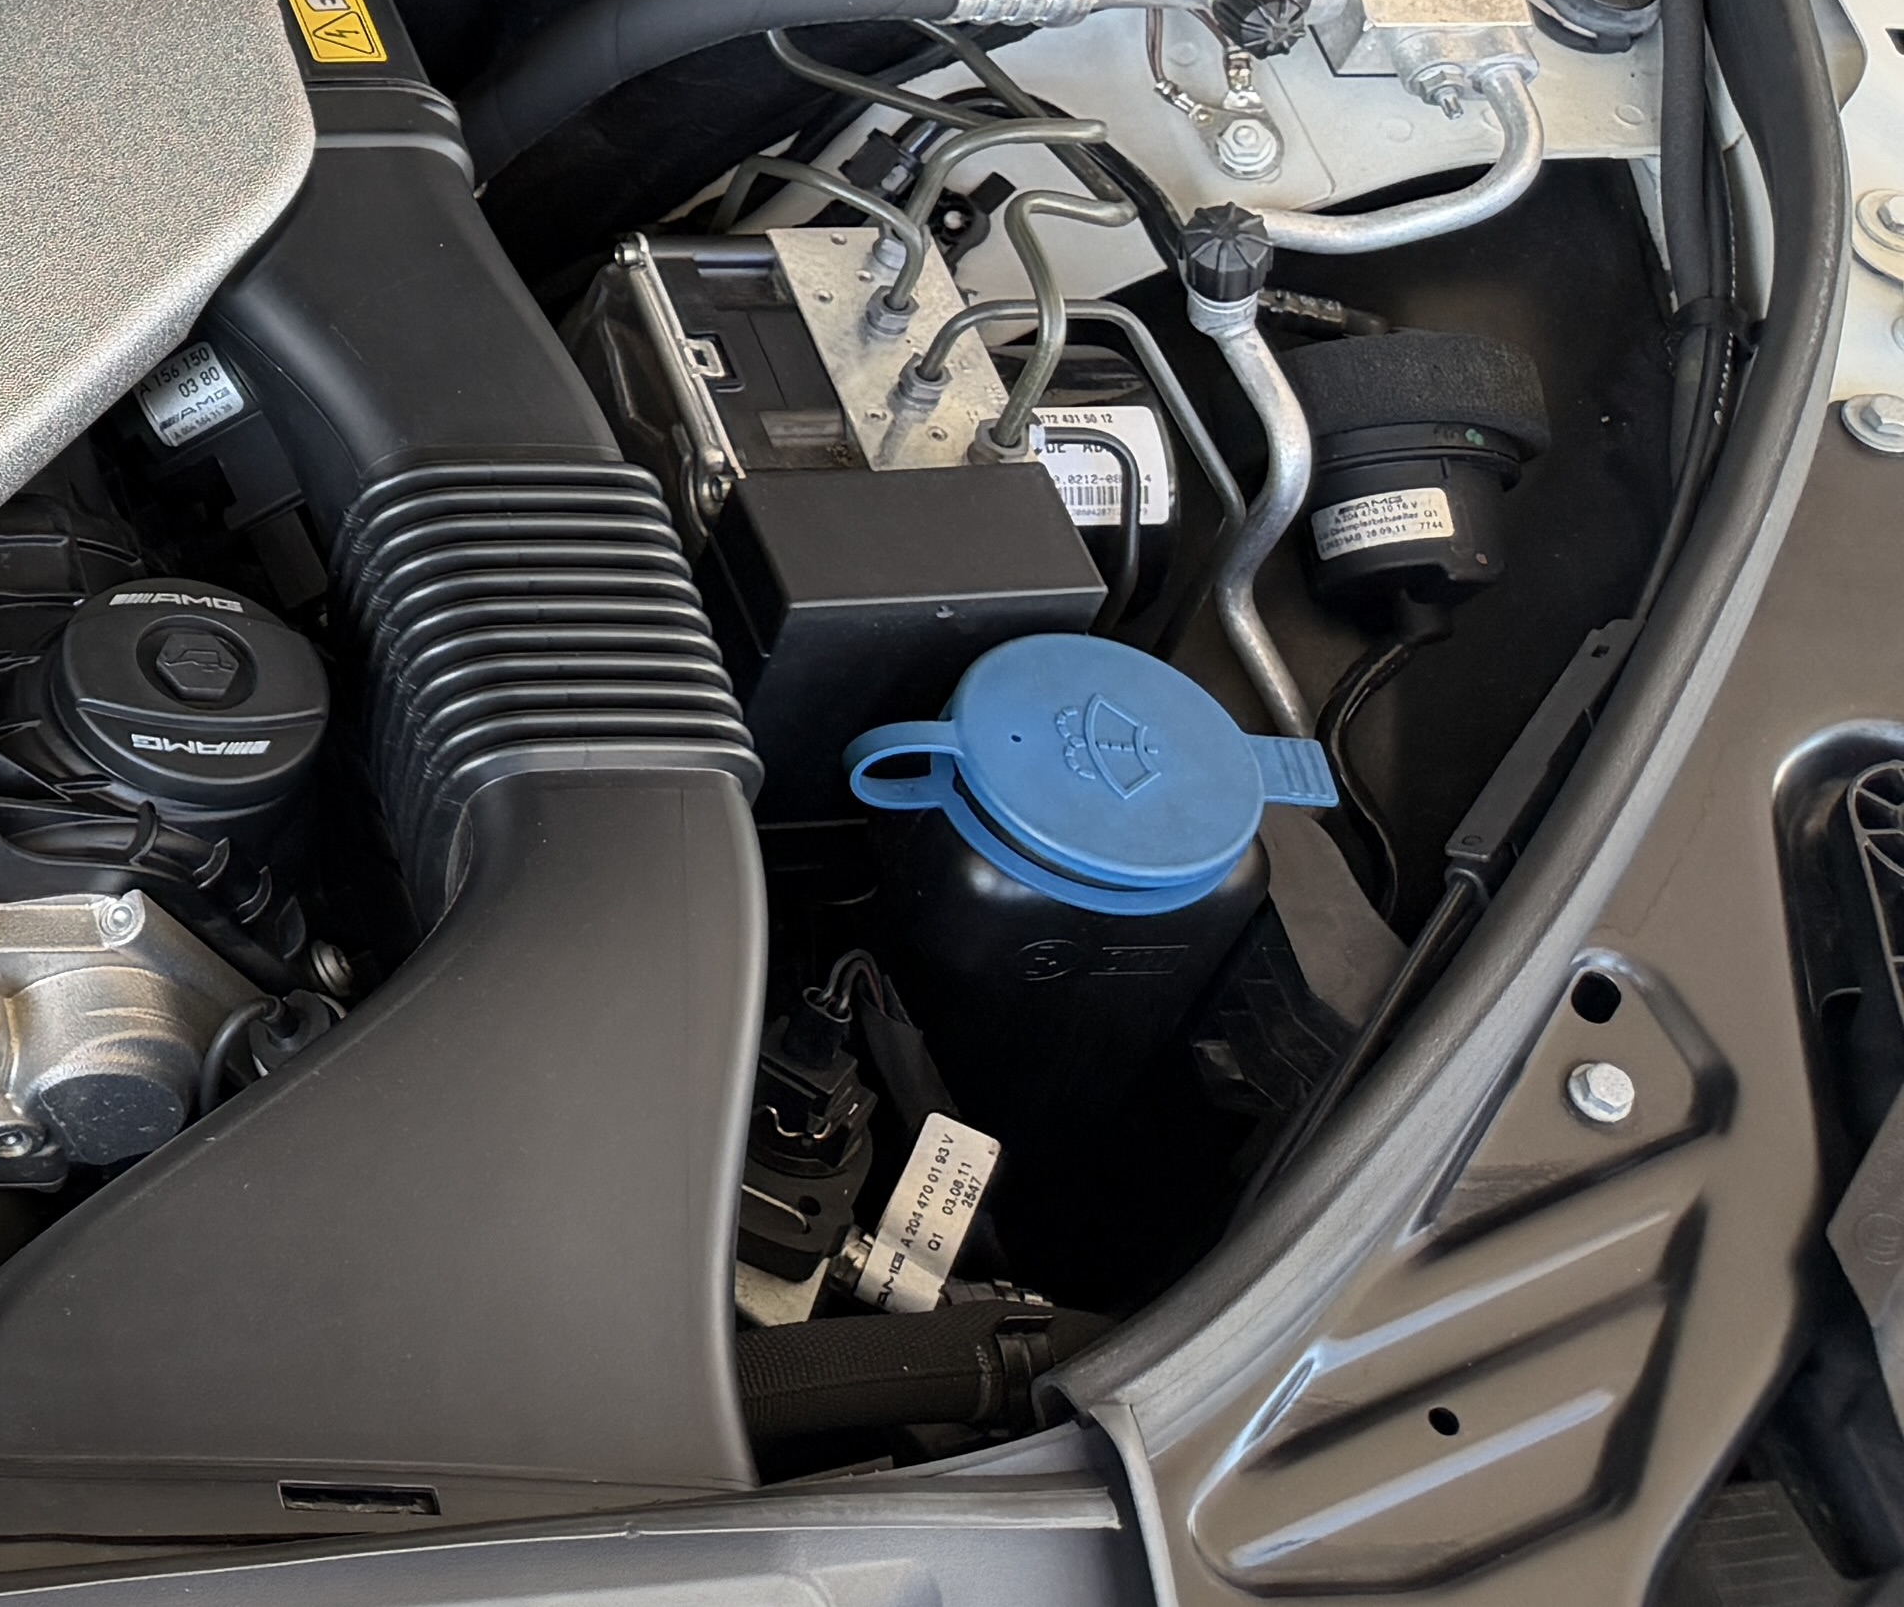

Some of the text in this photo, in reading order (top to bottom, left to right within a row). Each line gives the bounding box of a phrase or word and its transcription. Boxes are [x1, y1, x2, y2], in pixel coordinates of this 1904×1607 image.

[139, 346, 210, 396] A 156 150
[178, 366, 220, 398] 03 80
[1100, 413, 1114, 424] 12
[150, 593, 244, 613] AMG
[131, 733, 228, 755] AMG
[900, 1134, 954, 1249] A 204 470 01 93 V
[961, 1176, 983, 1209] 2547
[928, 1232, 945, 1252] Q1
[877, 1250, 905, 1305] AMG
